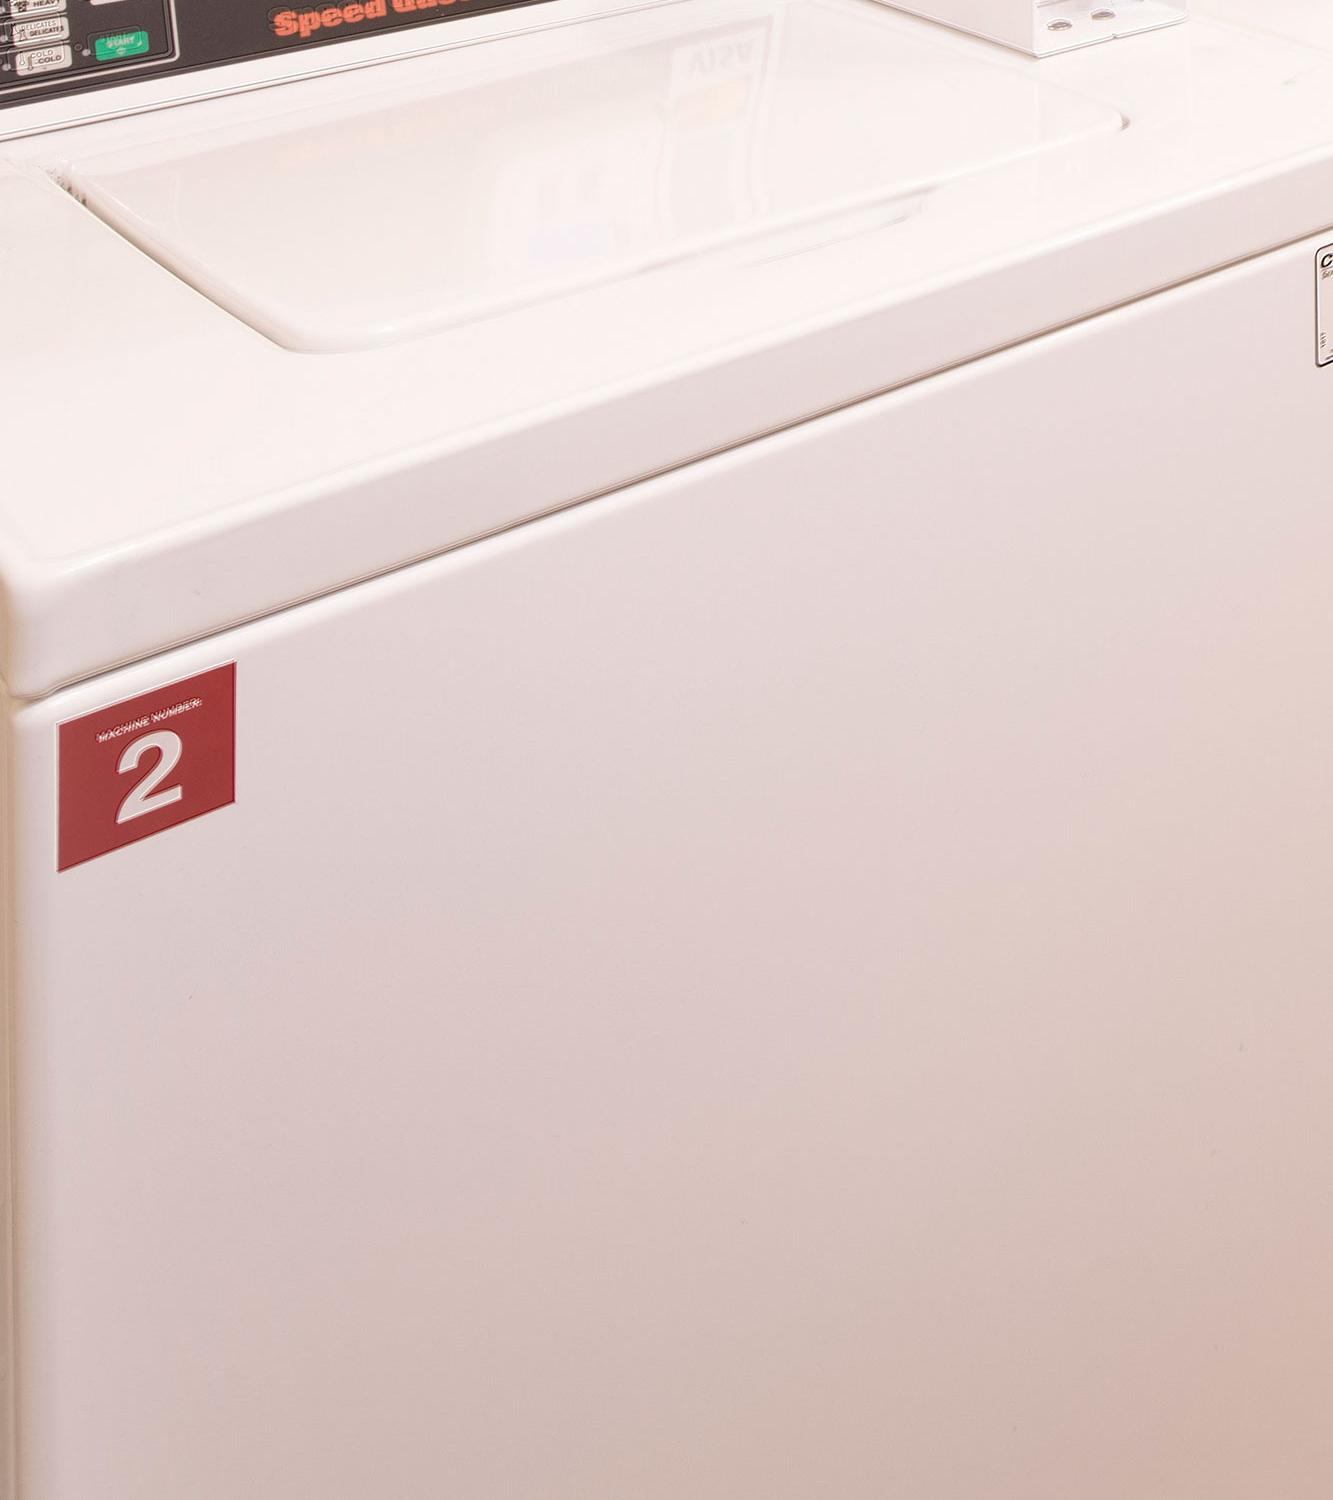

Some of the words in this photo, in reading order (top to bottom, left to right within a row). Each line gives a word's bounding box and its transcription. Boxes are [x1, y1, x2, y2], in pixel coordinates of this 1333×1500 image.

[29, 25, 64, 36] DELICATES
[38, 54, 62, 64] COLD
[115, 728, 183, 825] 2
